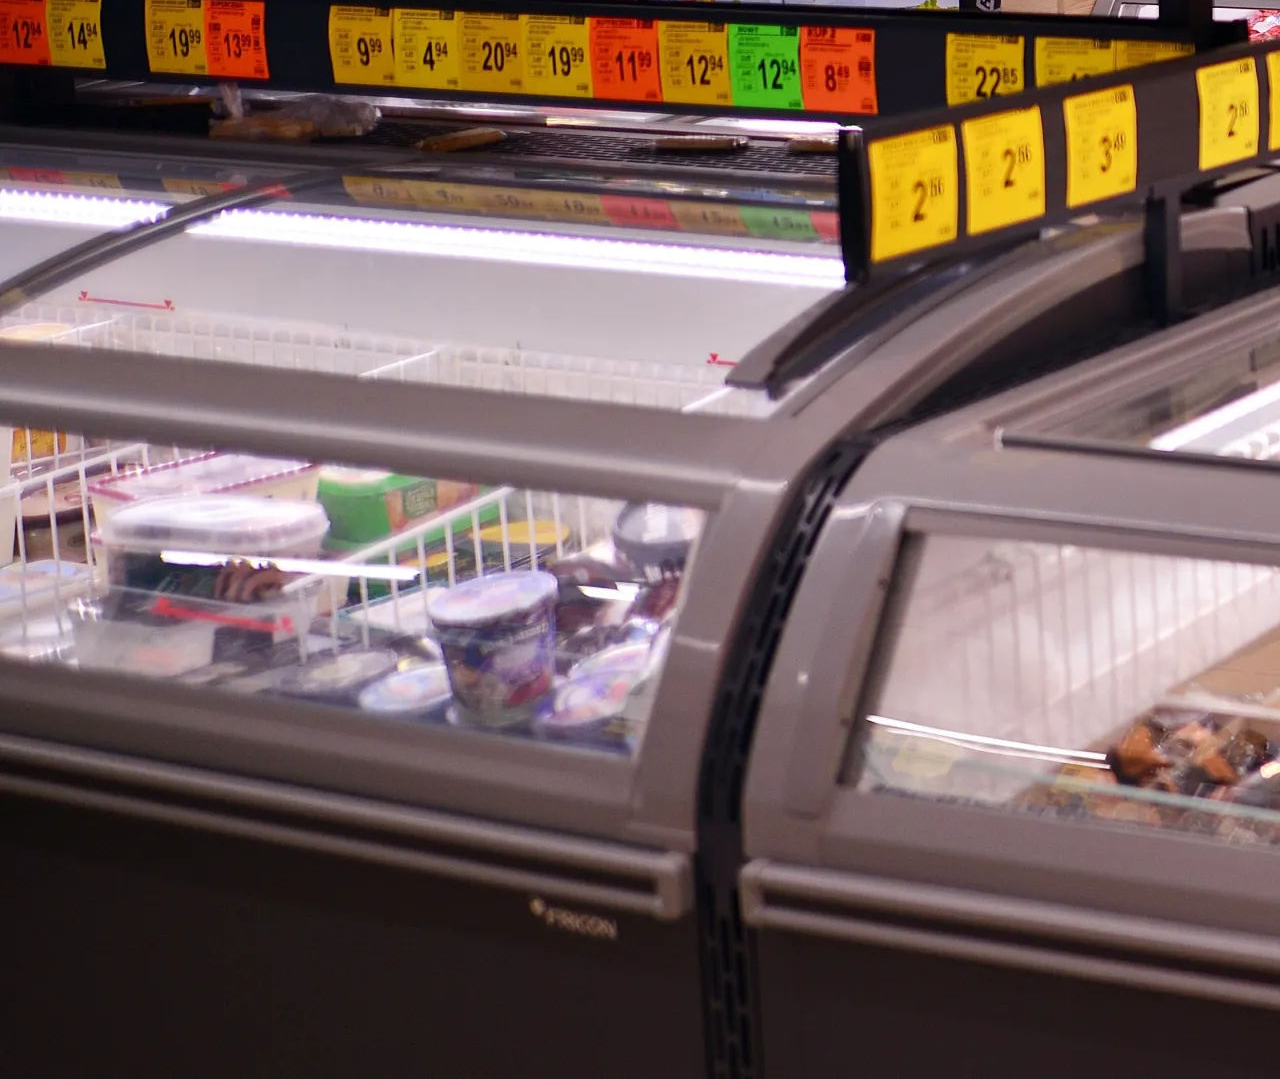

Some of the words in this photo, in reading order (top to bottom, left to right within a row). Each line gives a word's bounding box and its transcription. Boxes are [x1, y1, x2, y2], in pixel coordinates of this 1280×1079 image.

[12, 19, 42, 49] 1294
[68, 21, 98, 51] 1494
[169, 28, 202, 58] 1999
[224, 33, 252, 59] 1399
[357, 37, 382, 66] 999
[423, 41, 448, 71] 494
[482, 41, 517, 72] 2094
[548, 46, 584, 77] 1999
[616, 51, 652, 82] 1199
[687, 54, 724, 85] 1294
[758, 57, 796, 90] 1294
[825, 64, 850, 92] 849
[975, 65, 1018, 98] 2285
